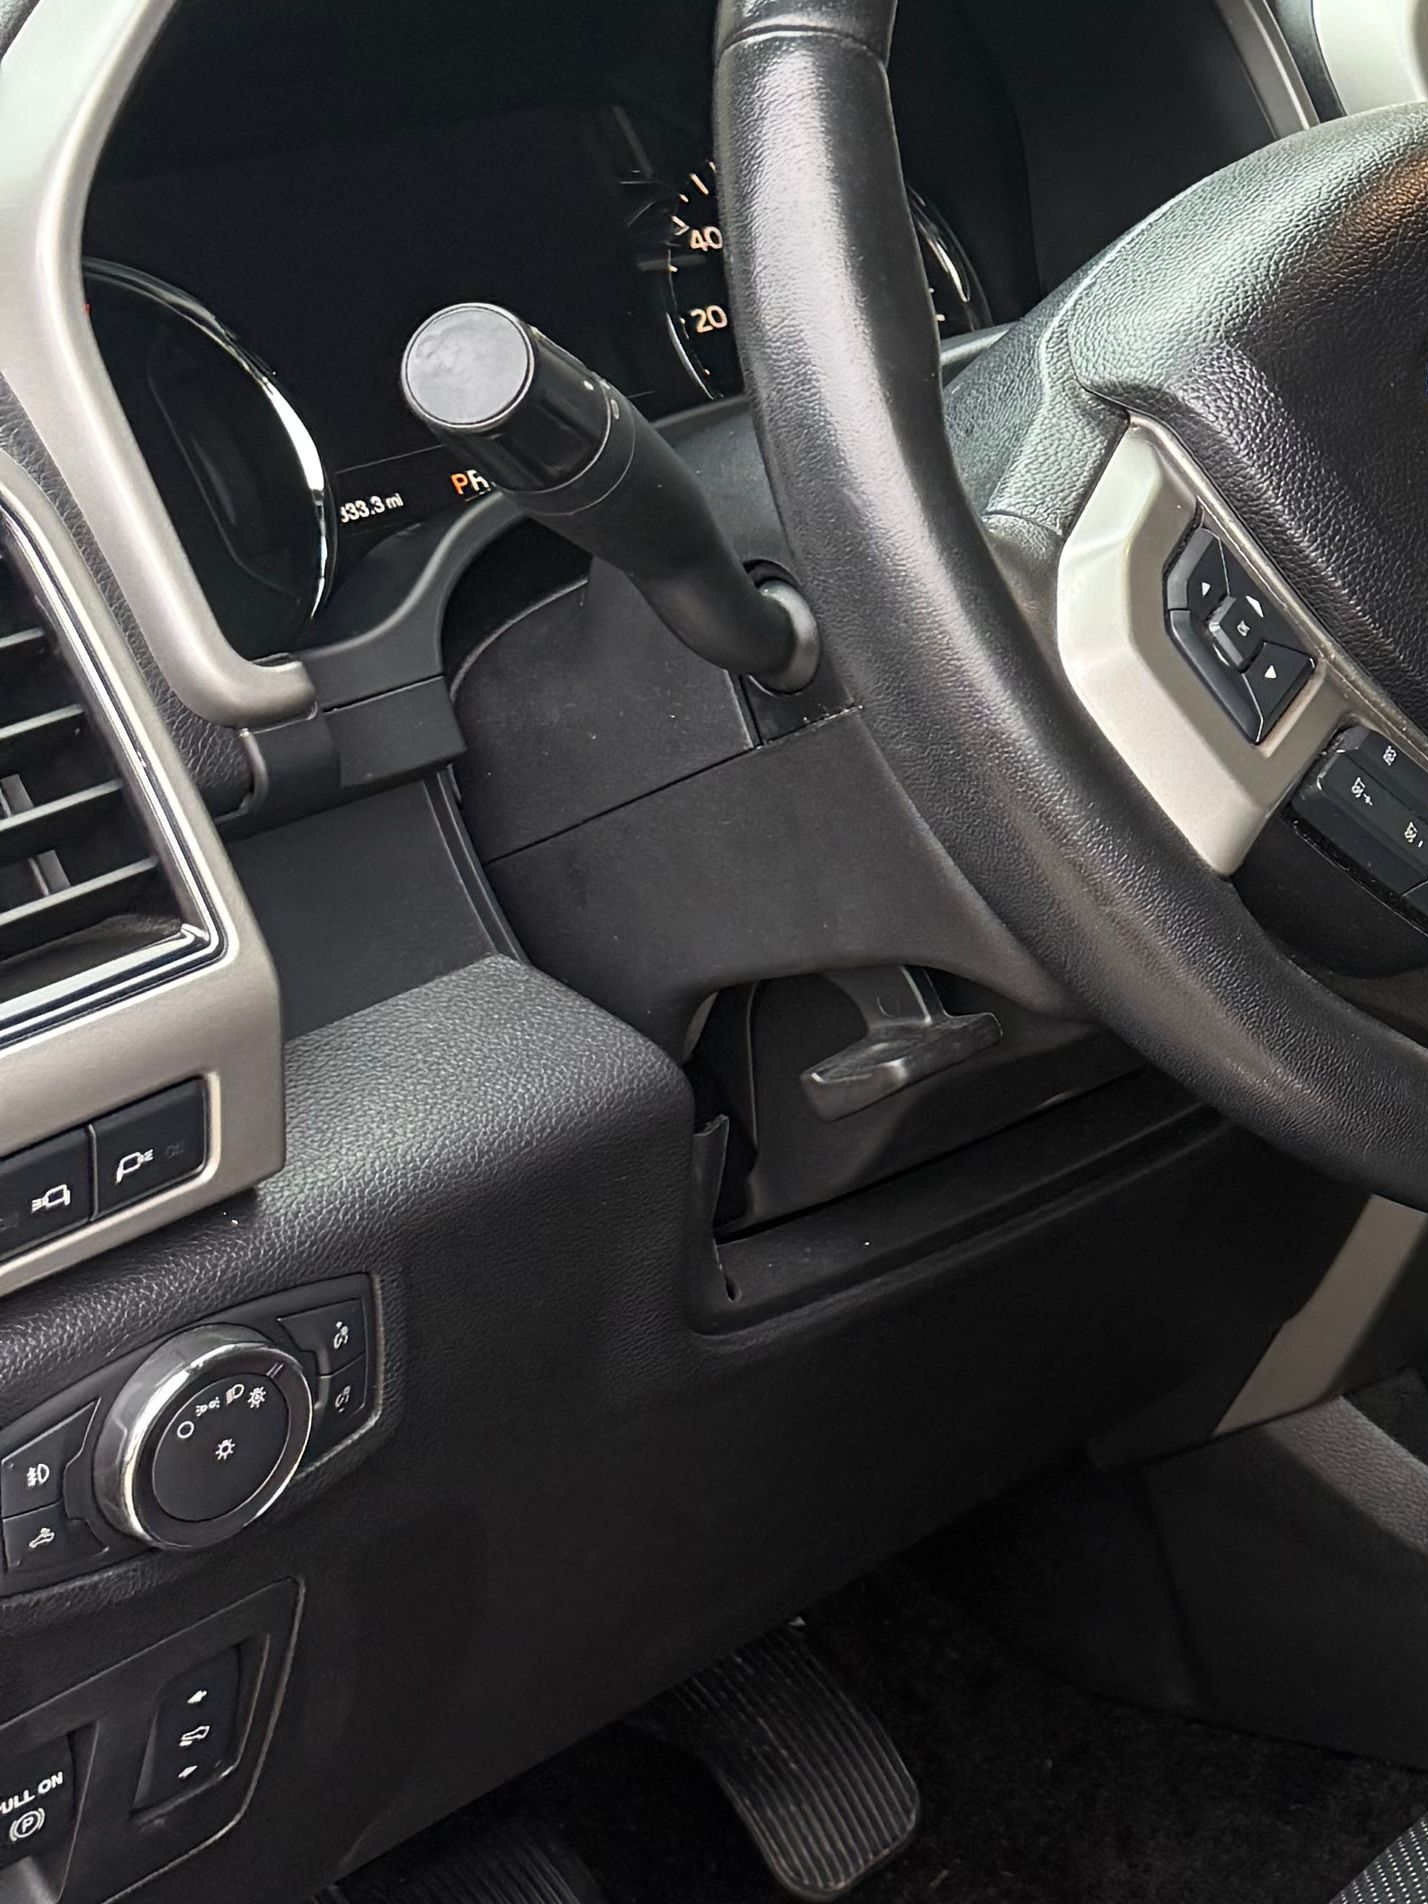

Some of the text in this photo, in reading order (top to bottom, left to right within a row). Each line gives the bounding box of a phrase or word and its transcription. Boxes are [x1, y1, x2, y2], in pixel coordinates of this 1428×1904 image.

[690, 225, 723, 251] 40
[690, 304, 728, 334] 20
[450, 472, 468, 495] P
[1351, 777, 1366, 798] SET
[1404, 821, 1418, 843] SET
[0, 1771, 63, 1814] ULL ON
